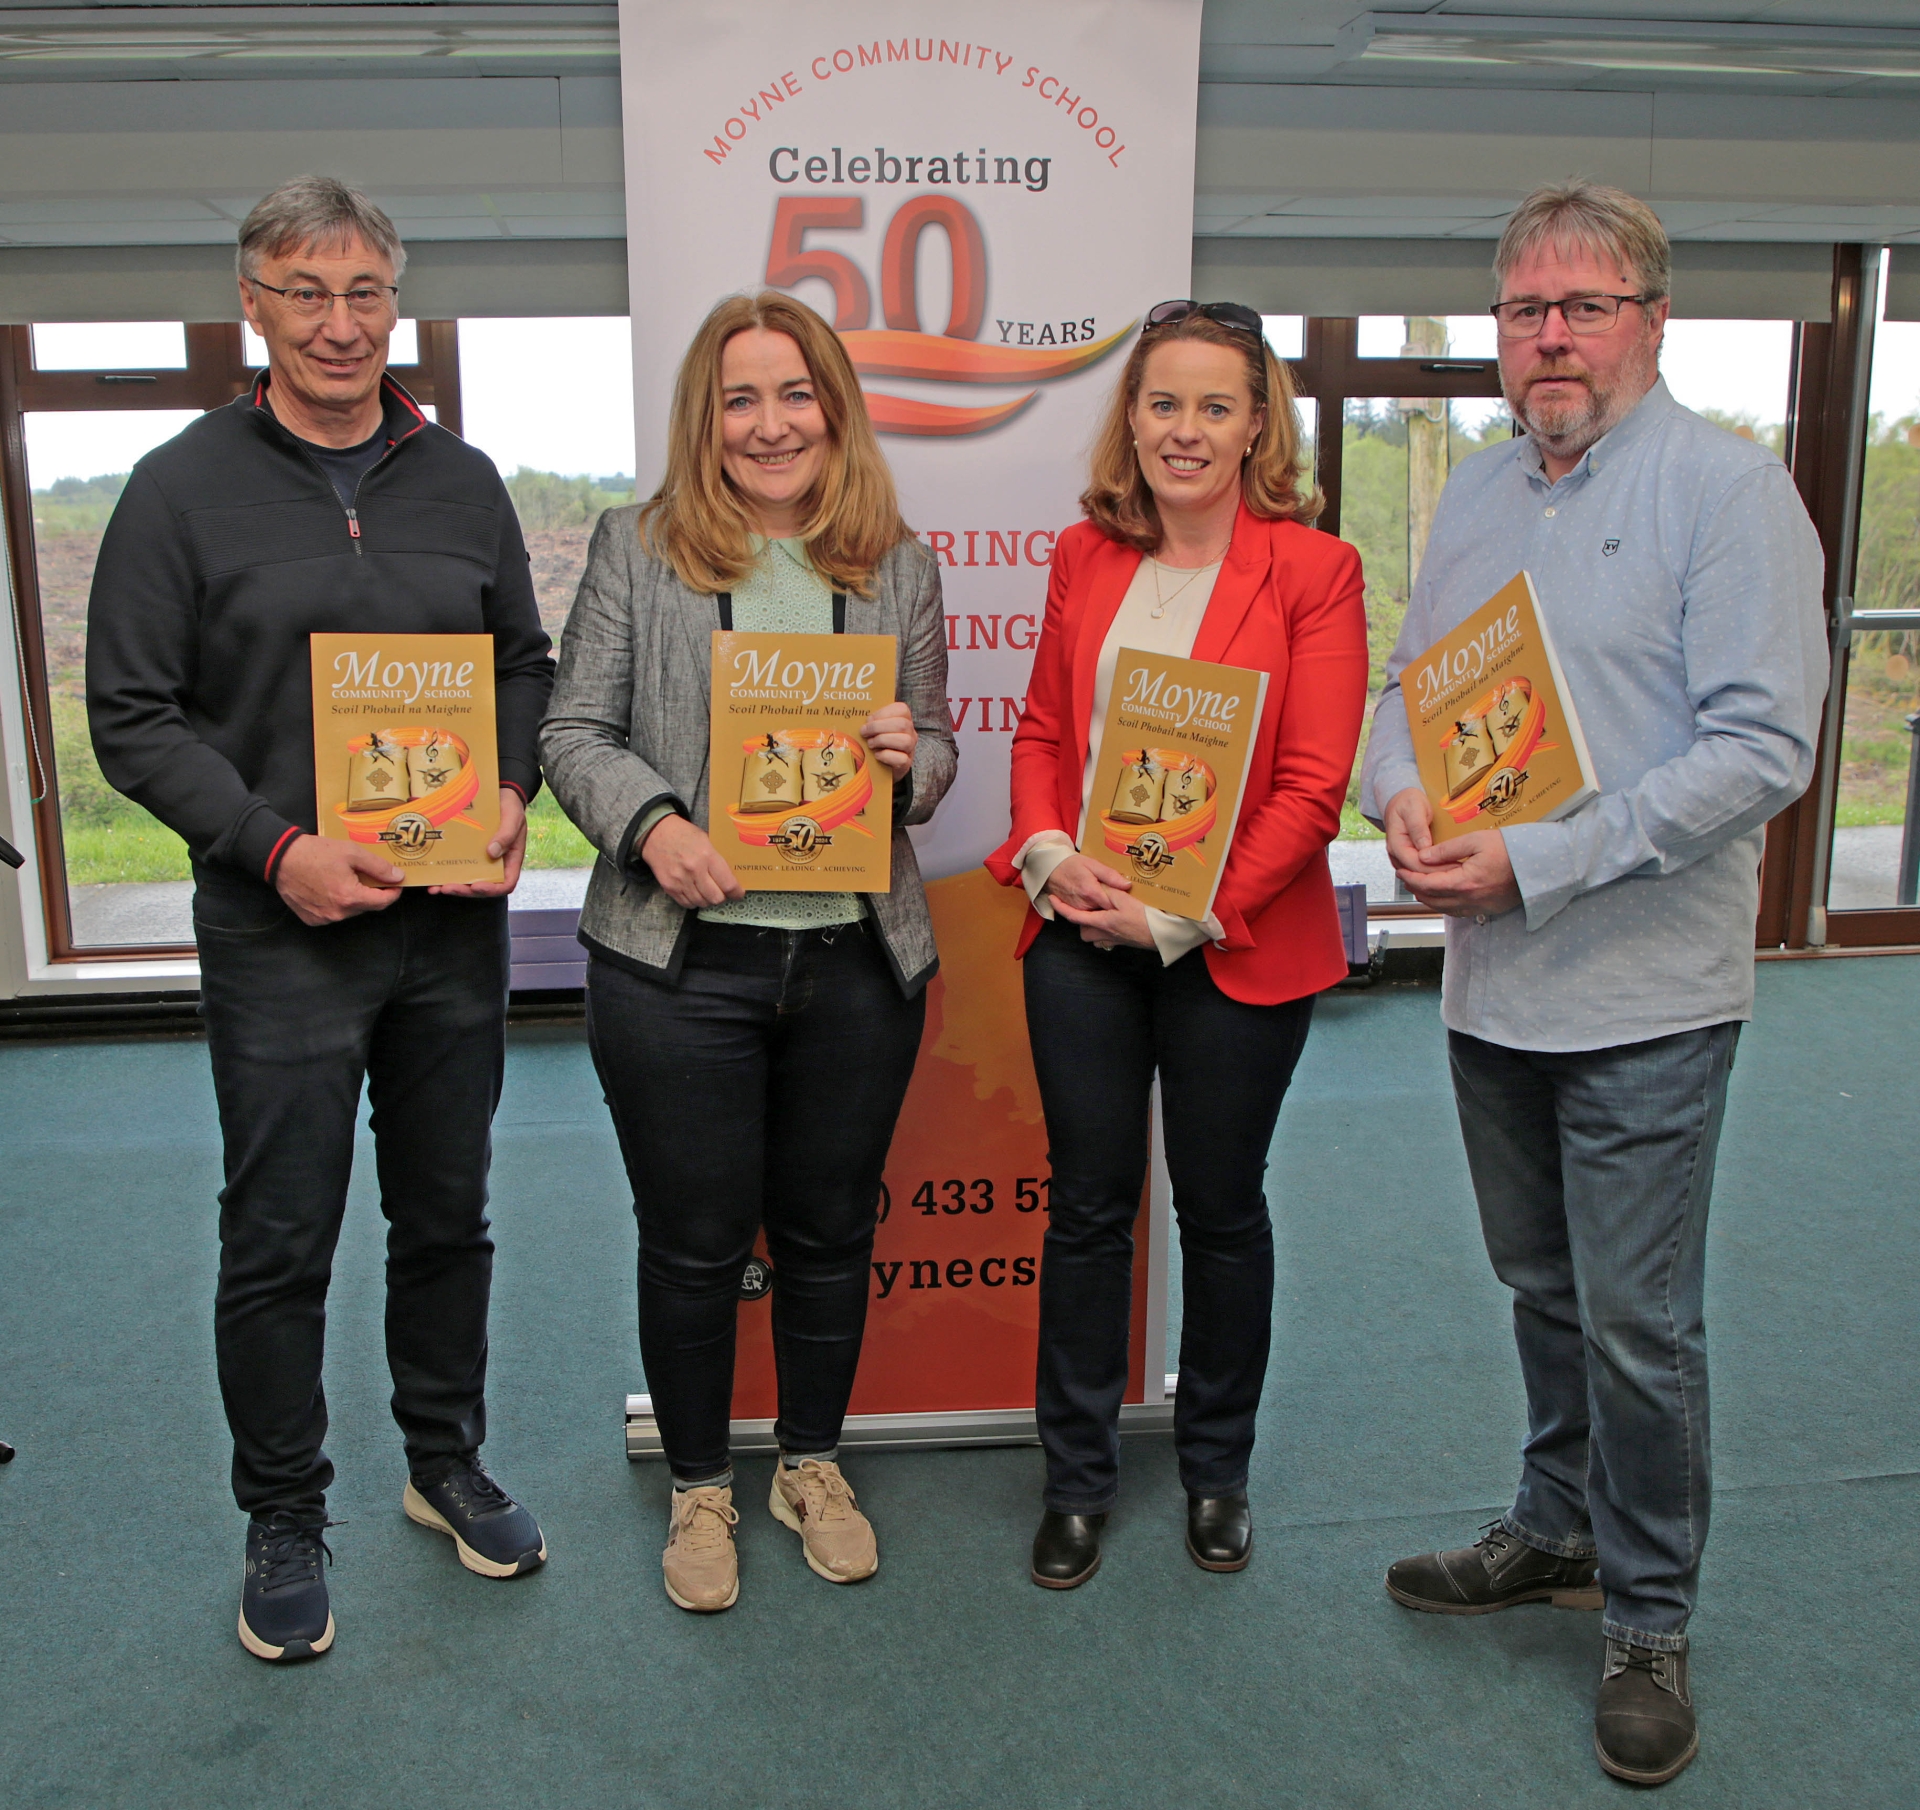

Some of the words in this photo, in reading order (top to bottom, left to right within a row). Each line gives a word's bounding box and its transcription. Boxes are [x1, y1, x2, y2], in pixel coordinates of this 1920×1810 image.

[703, 71, 803, 165] MOYNE
[811, 38, 1013, 80] COMMUNITY
[1022, 66, 1128, 168] SCHOOL
[768, 147, 1052, 192] Celebrating
[764, 194, 987, 341] 50
[995, 317, 1096, 346] YEARS
[1417, 605, 1519, 706] Moyne
[1419, 666, 1478, 713] COMMUNITY
[1486, 630, 1522, 663] SCHOOL
[331, 650, 474, 704] Moyne
[730, 649, 876, 705] Moyne
[1422, 707, 1443, 727] Scoil
[1444, 682, 1477, 710] Phobail
[1478, 673, 1489, 685] na
[1490, 643, 1525, 676] Maighne
[331, 689, 410, 699] COMMUNITY
[424, 689, 472, 699] SCHOOL
[730, 688, 809, 699] COMMUNITY
[823, 691, 872, 701] SCHOOL
[1123, 668, 1240, 729] Moyne
[331, 705, 359, 714] Scoil
[362, 705, 405, 715] Phobail
[425, 705, 472, 716] Maighne
[728, 704, 756, 714] Scoil
[760, 705, 803, 715] Phobail
[823, 707, 871, 719] Maighne
[1121, 702, 1182, 722] COMMUNITY
[1192, 717, 1232, 733] SCHOOL
[1117, 717, 1138, 729] Scoil
[1140, 722, 1175, 737] Phobail
[1176, 730, 1188, 740] na
[1189, 732, 1229, 749] Maighne
[1489, 773, 1515, 805] 50
[1528, 777, 1562, 805] ACHIEVING
[392, 821, 426, 847] 50
[781, 825, 816, 851] 50
[1134, 840, 1164, 866] 50
[1130, 875, 1155, 887] LEADING
[1160, 884, 1191, 897] ACHIEVING
[911, 1179, 994, 1216] 433
[872, 1256, 1036, 1299] ynecs
